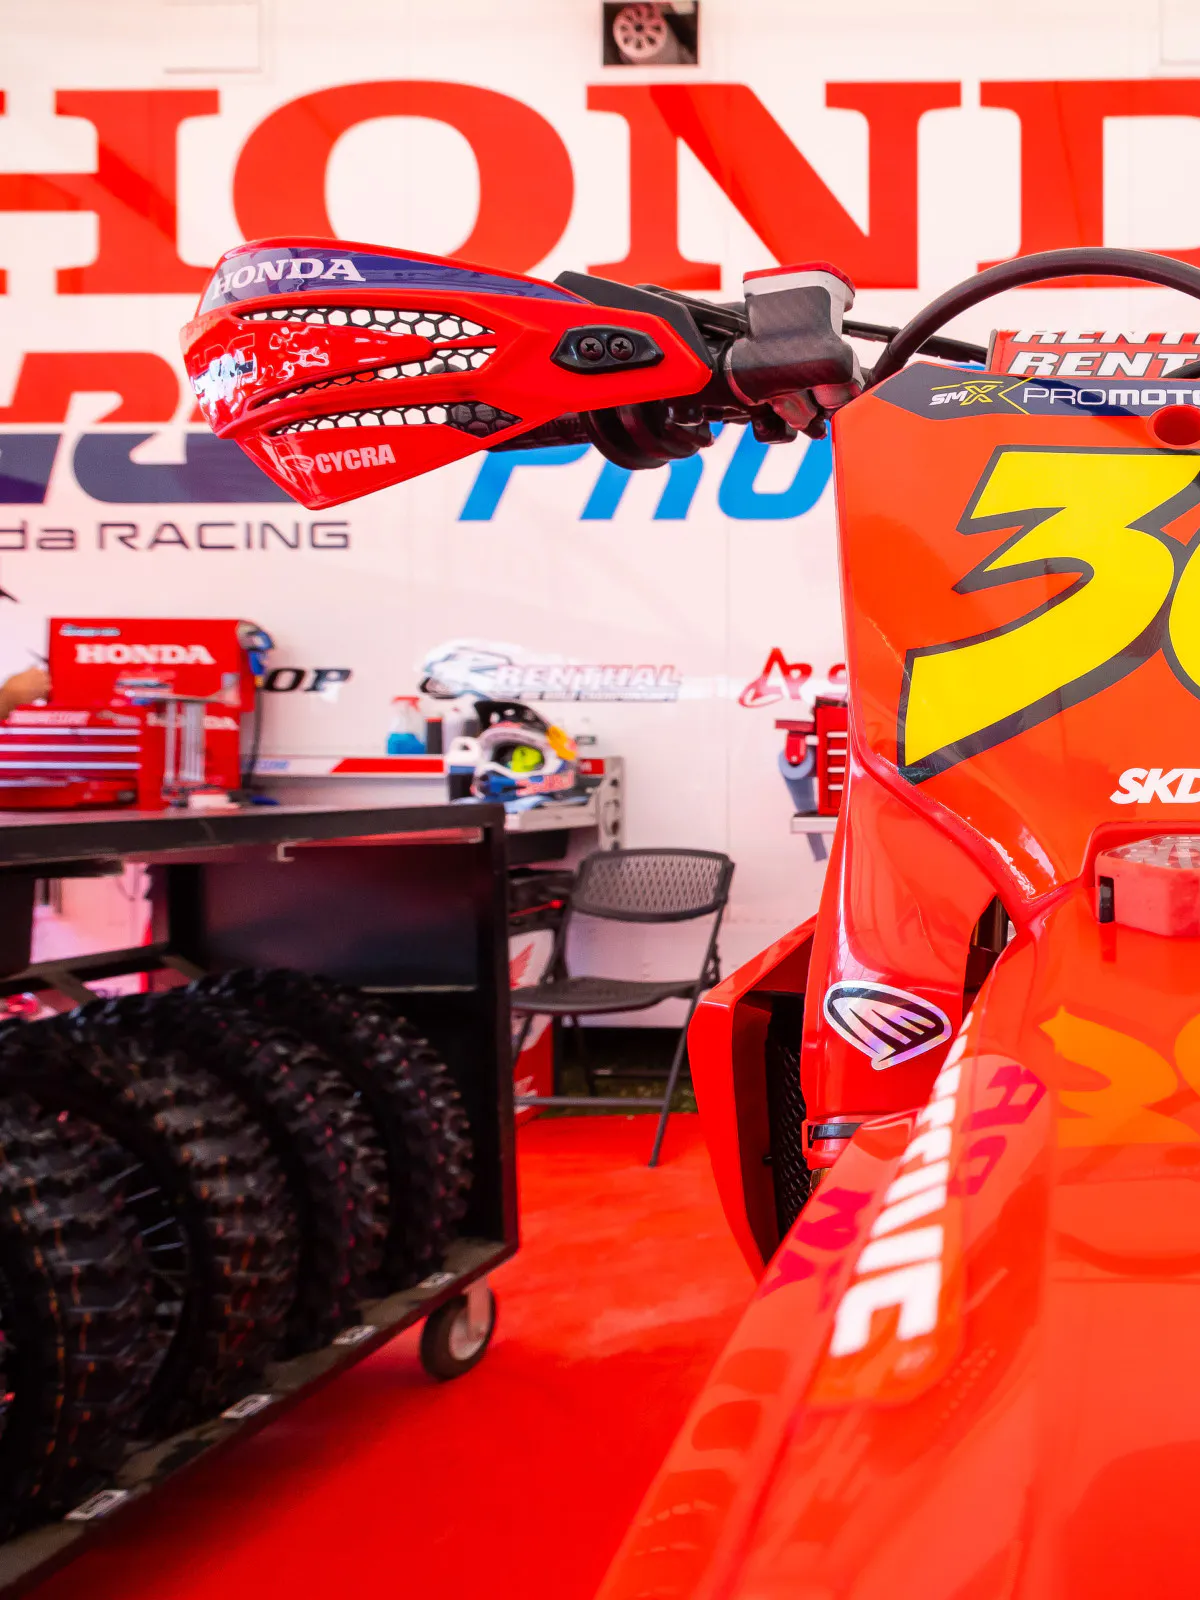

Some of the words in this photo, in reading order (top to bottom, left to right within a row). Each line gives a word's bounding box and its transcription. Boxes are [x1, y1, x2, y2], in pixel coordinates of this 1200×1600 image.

[211, 257, 366, 300] HONDA
[315, 444, 396, 474] CYCRA
[0, 521, 76, 549] da
[98, 522, 351, 550] RACING
[75, 643, 216, 665] HONDA
